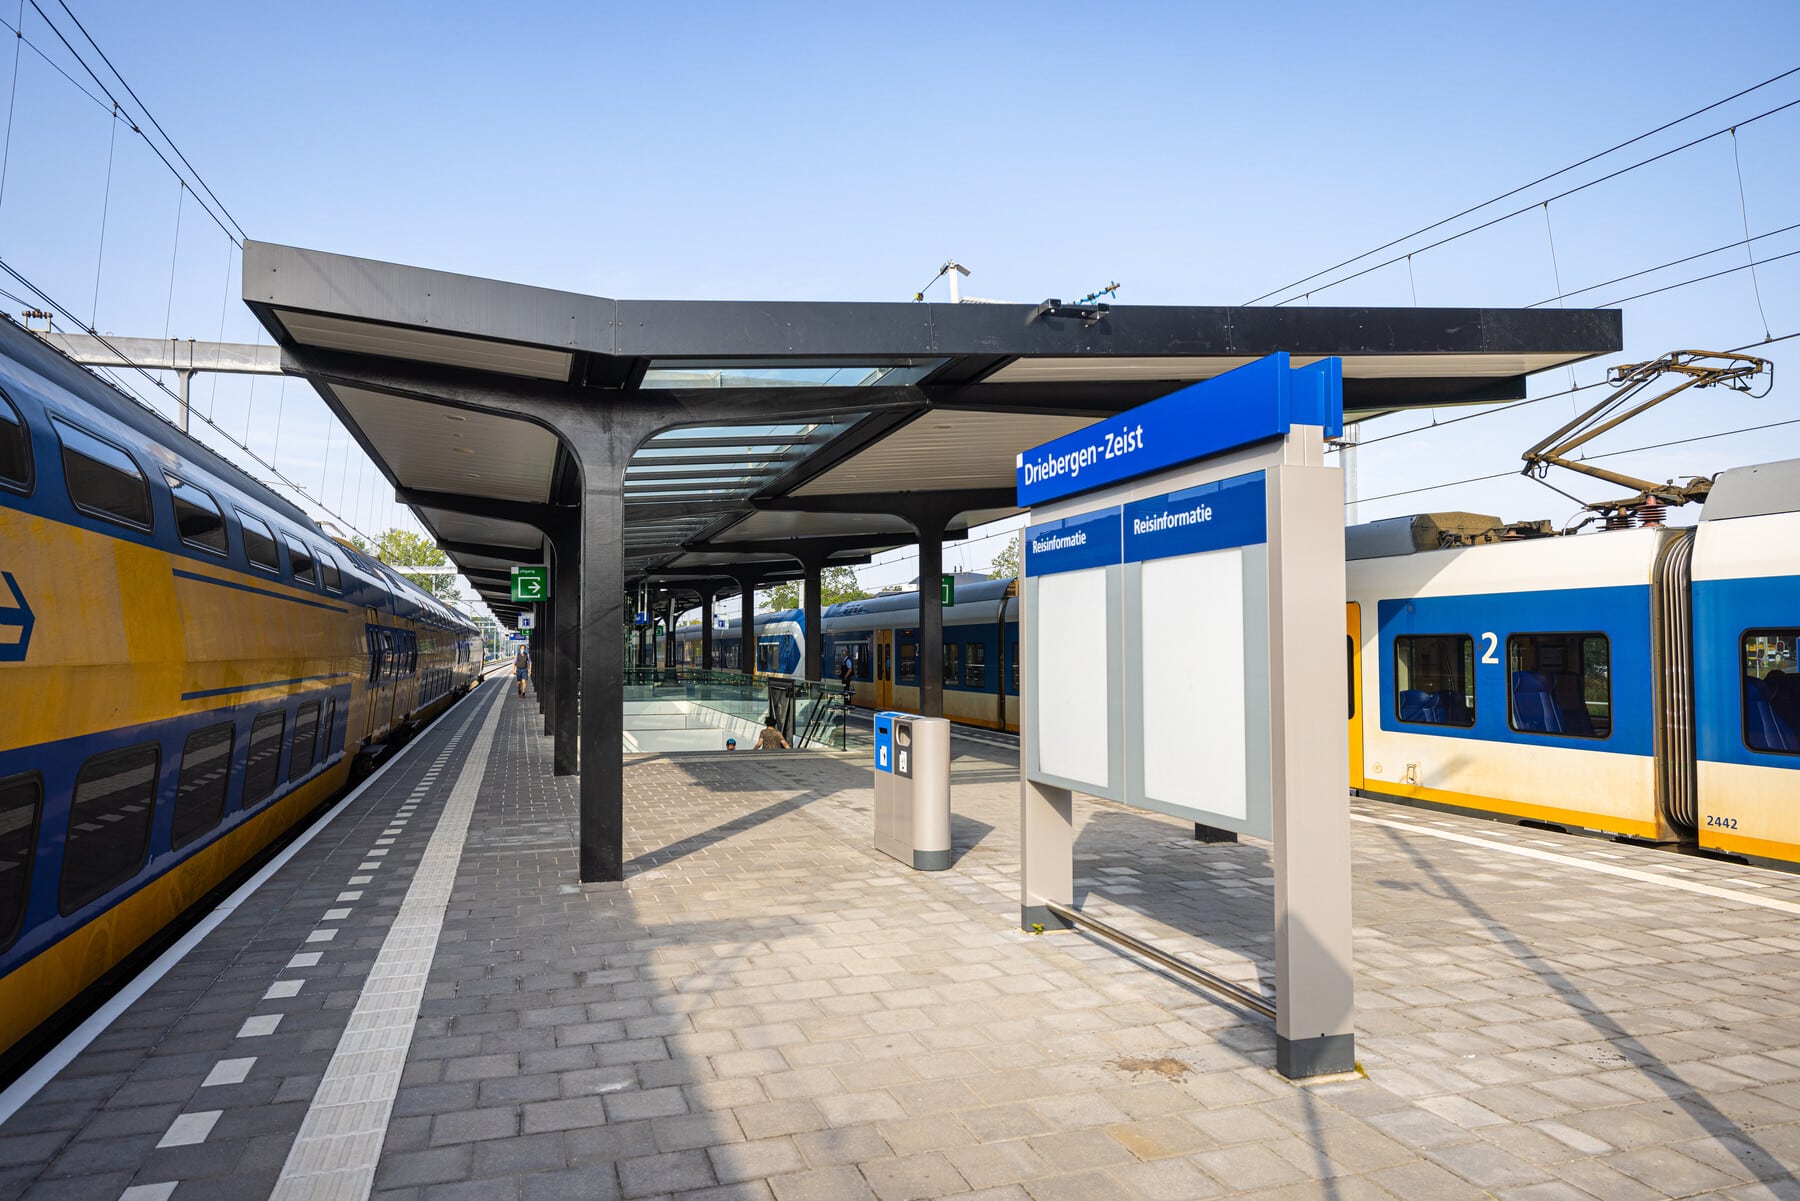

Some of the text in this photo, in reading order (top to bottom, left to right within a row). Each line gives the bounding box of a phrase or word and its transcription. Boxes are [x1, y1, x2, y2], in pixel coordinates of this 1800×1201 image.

[1024, 424, 1144, 486] Driebergen-Zeist
[1133, 504, 1212, 536] Reisinformatie
[1032, 530, 1087, 554] Reisinformatie
[1481, 631, 1499, 665] 2
[1707, 815, 1738, 830] 2442
